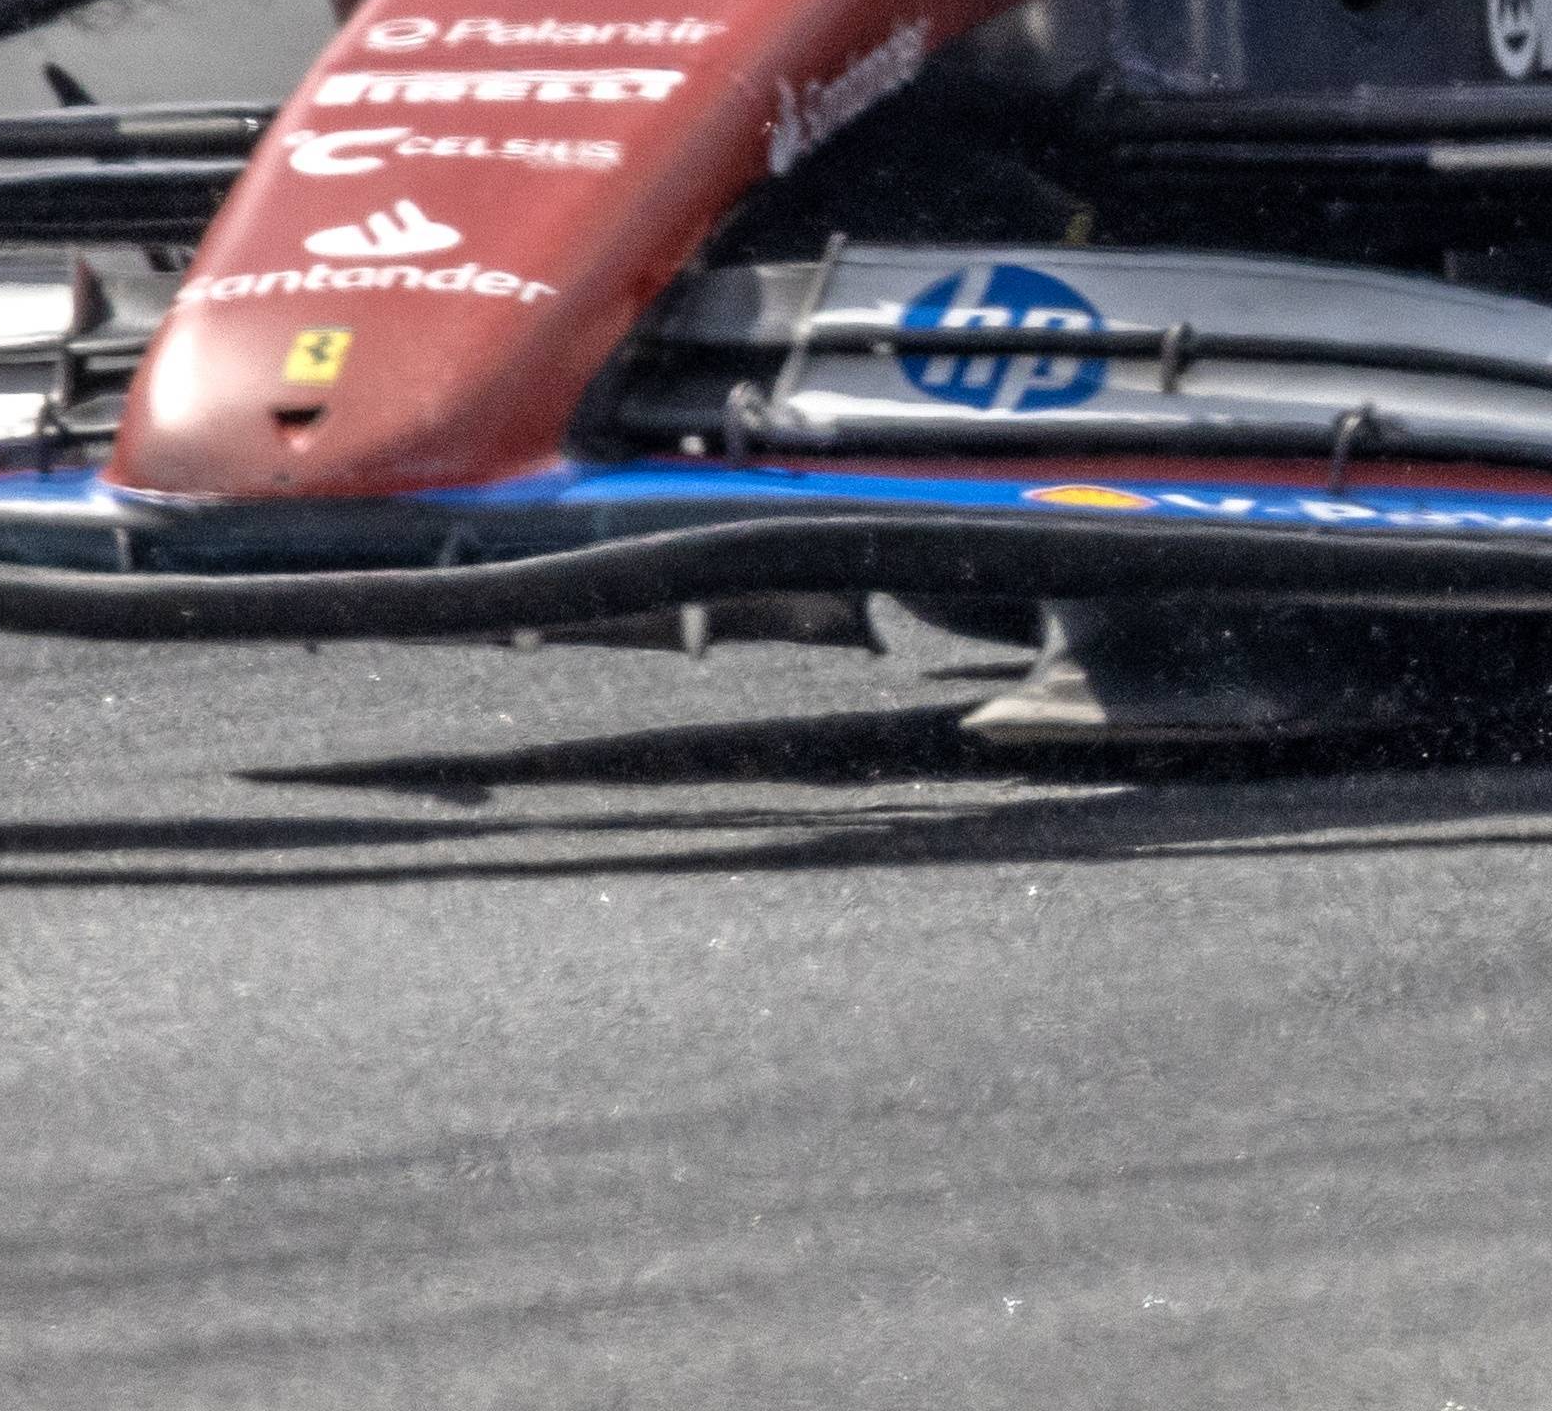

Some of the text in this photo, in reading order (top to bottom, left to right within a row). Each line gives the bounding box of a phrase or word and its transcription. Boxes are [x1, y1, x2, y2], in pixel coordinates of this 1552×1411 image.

[443, 15, 732, 47] Palantir
[312, 67, 690, 107] PIRELLI
[918, 263, 1096, 410] hp
